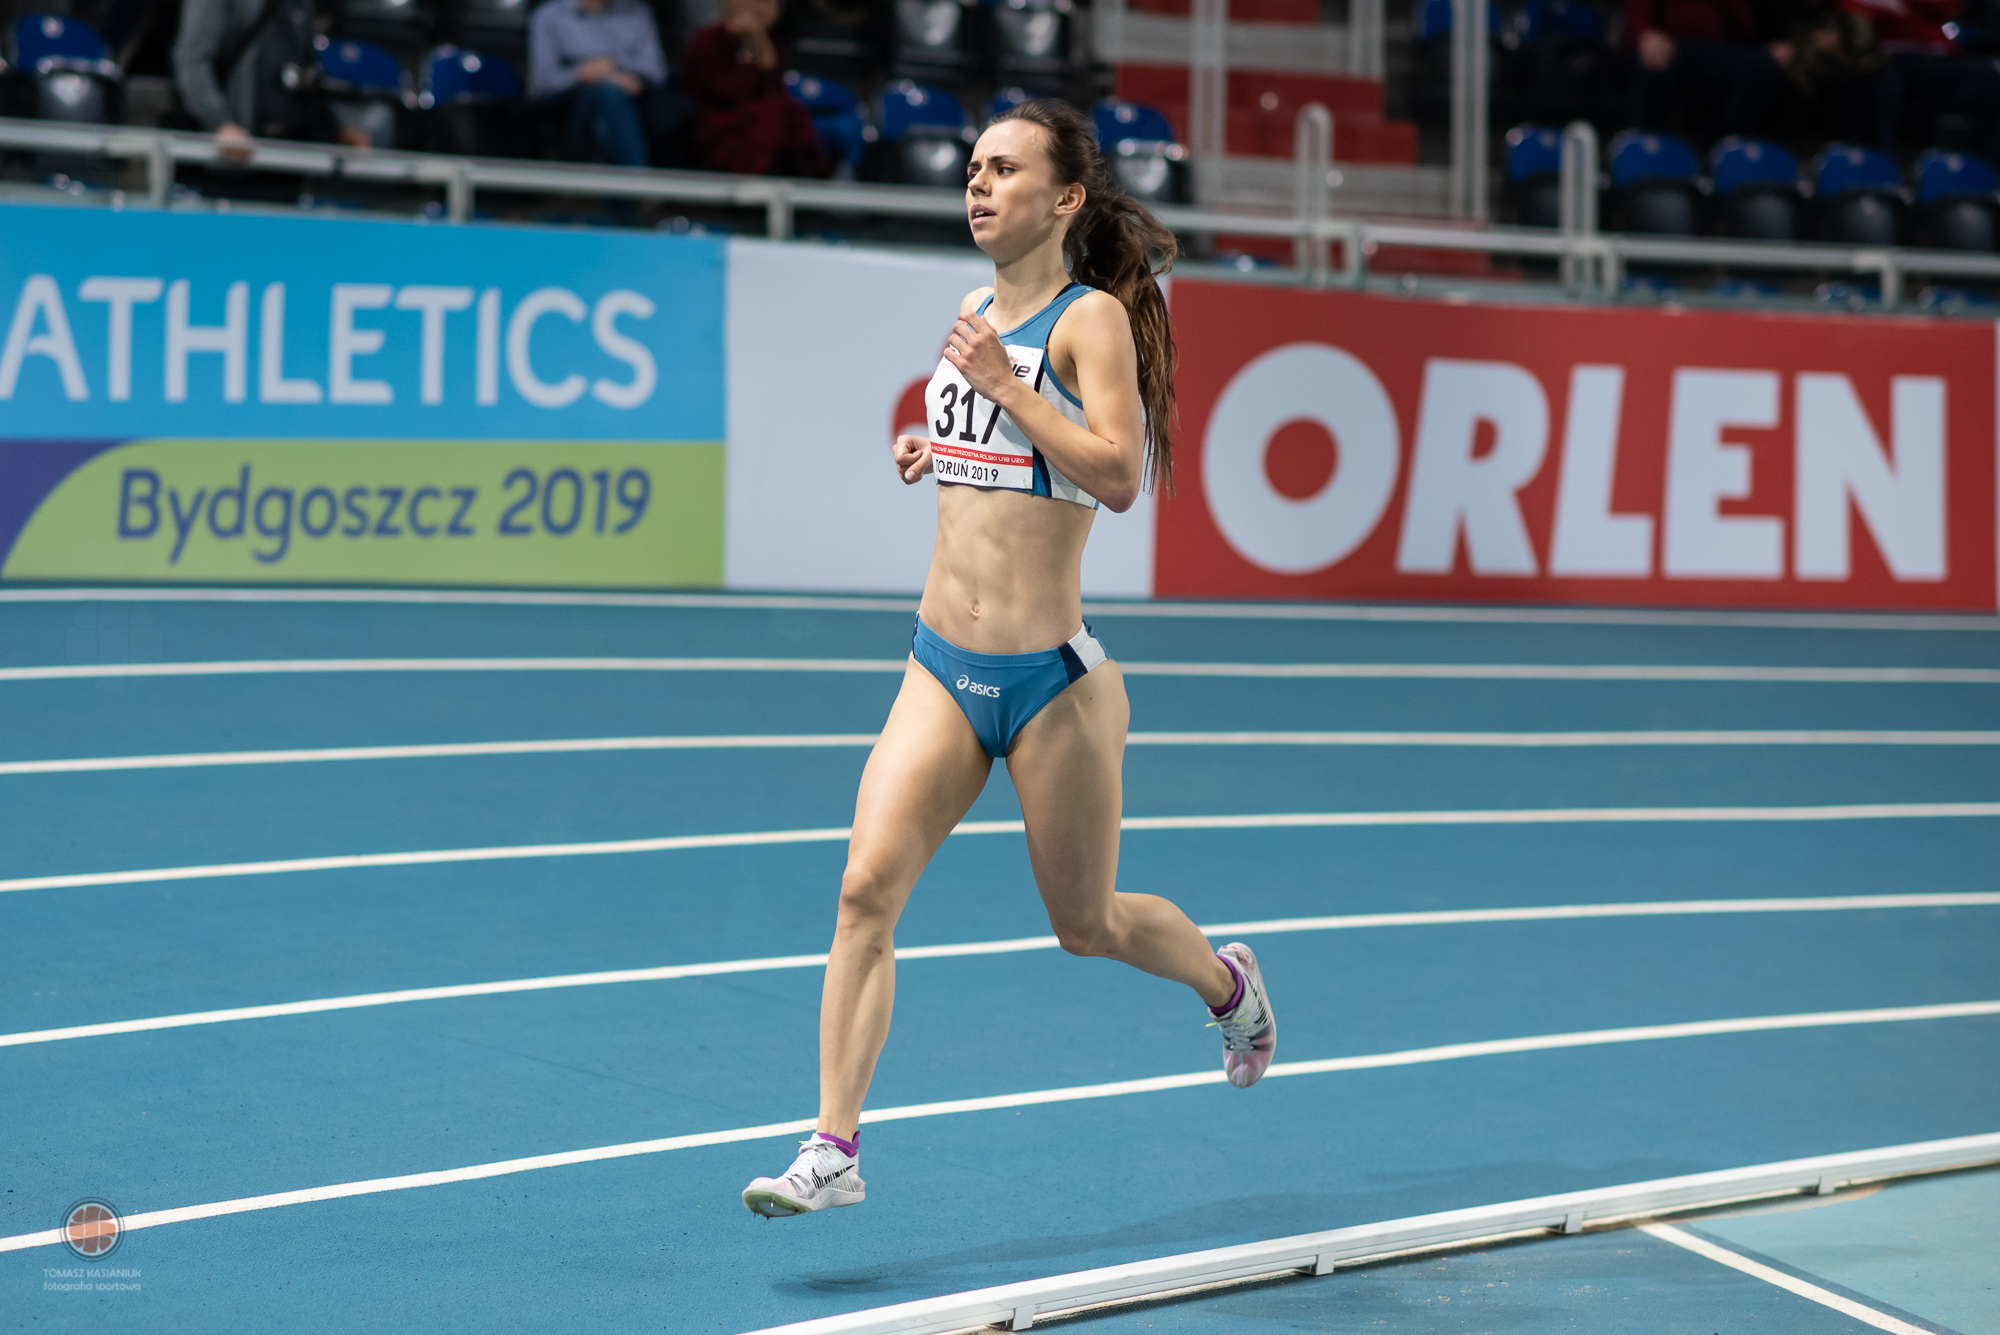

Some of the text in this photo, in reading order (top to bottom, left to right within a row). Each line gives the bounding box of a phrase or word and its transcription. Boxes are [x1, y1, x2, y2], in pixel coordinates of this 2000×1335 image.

[0, 273, 658, 410] ATHLETICS
[116, 462, 654, 566] Bydgoszcz 2019
[971, 465, 999, 482] 2019
[1202, 341, 1947, 584] ORLEN
